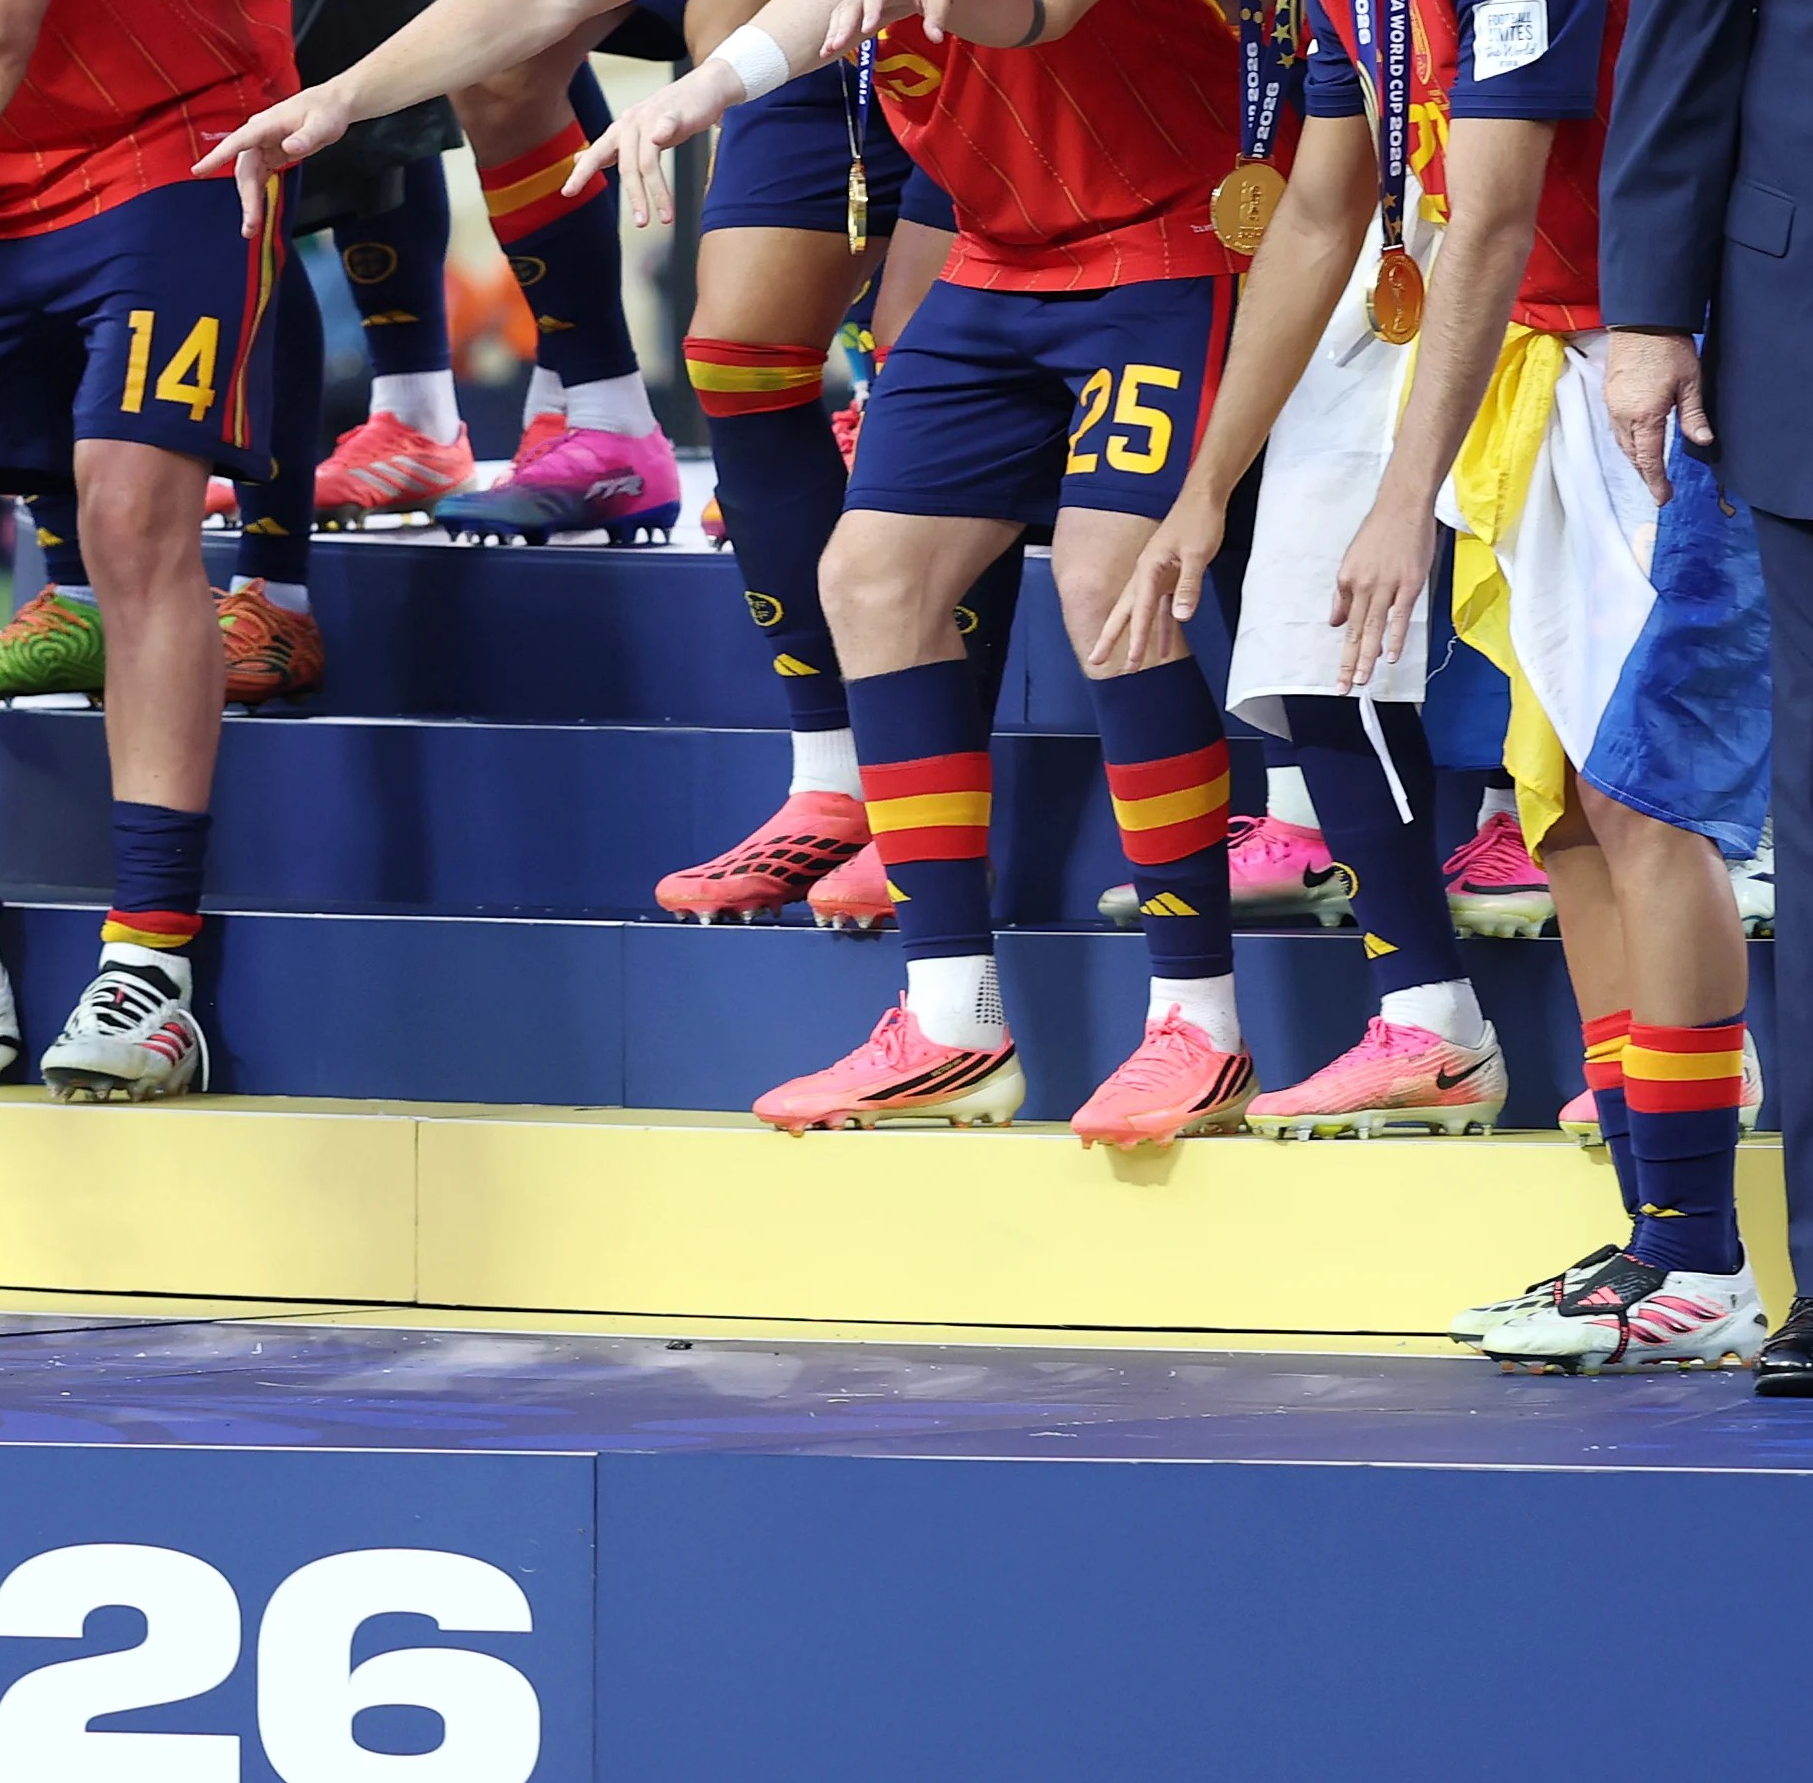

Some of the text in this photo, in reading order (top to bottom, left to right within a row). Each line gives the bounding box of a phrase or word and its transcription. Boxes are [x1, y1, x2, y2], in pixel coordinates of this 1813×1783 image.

[858, 38, 873, 105] FIFA WO
[1389, 12, 1406, 77] WORLD
[1256, 82, 1280, 140] 2026
[1389, 78, 1404, 114] CUP
[1388, 116, 1404, 177] 2026
[120, 309, 220, 422] 14
[1065, 363, 1182, 475] 25
